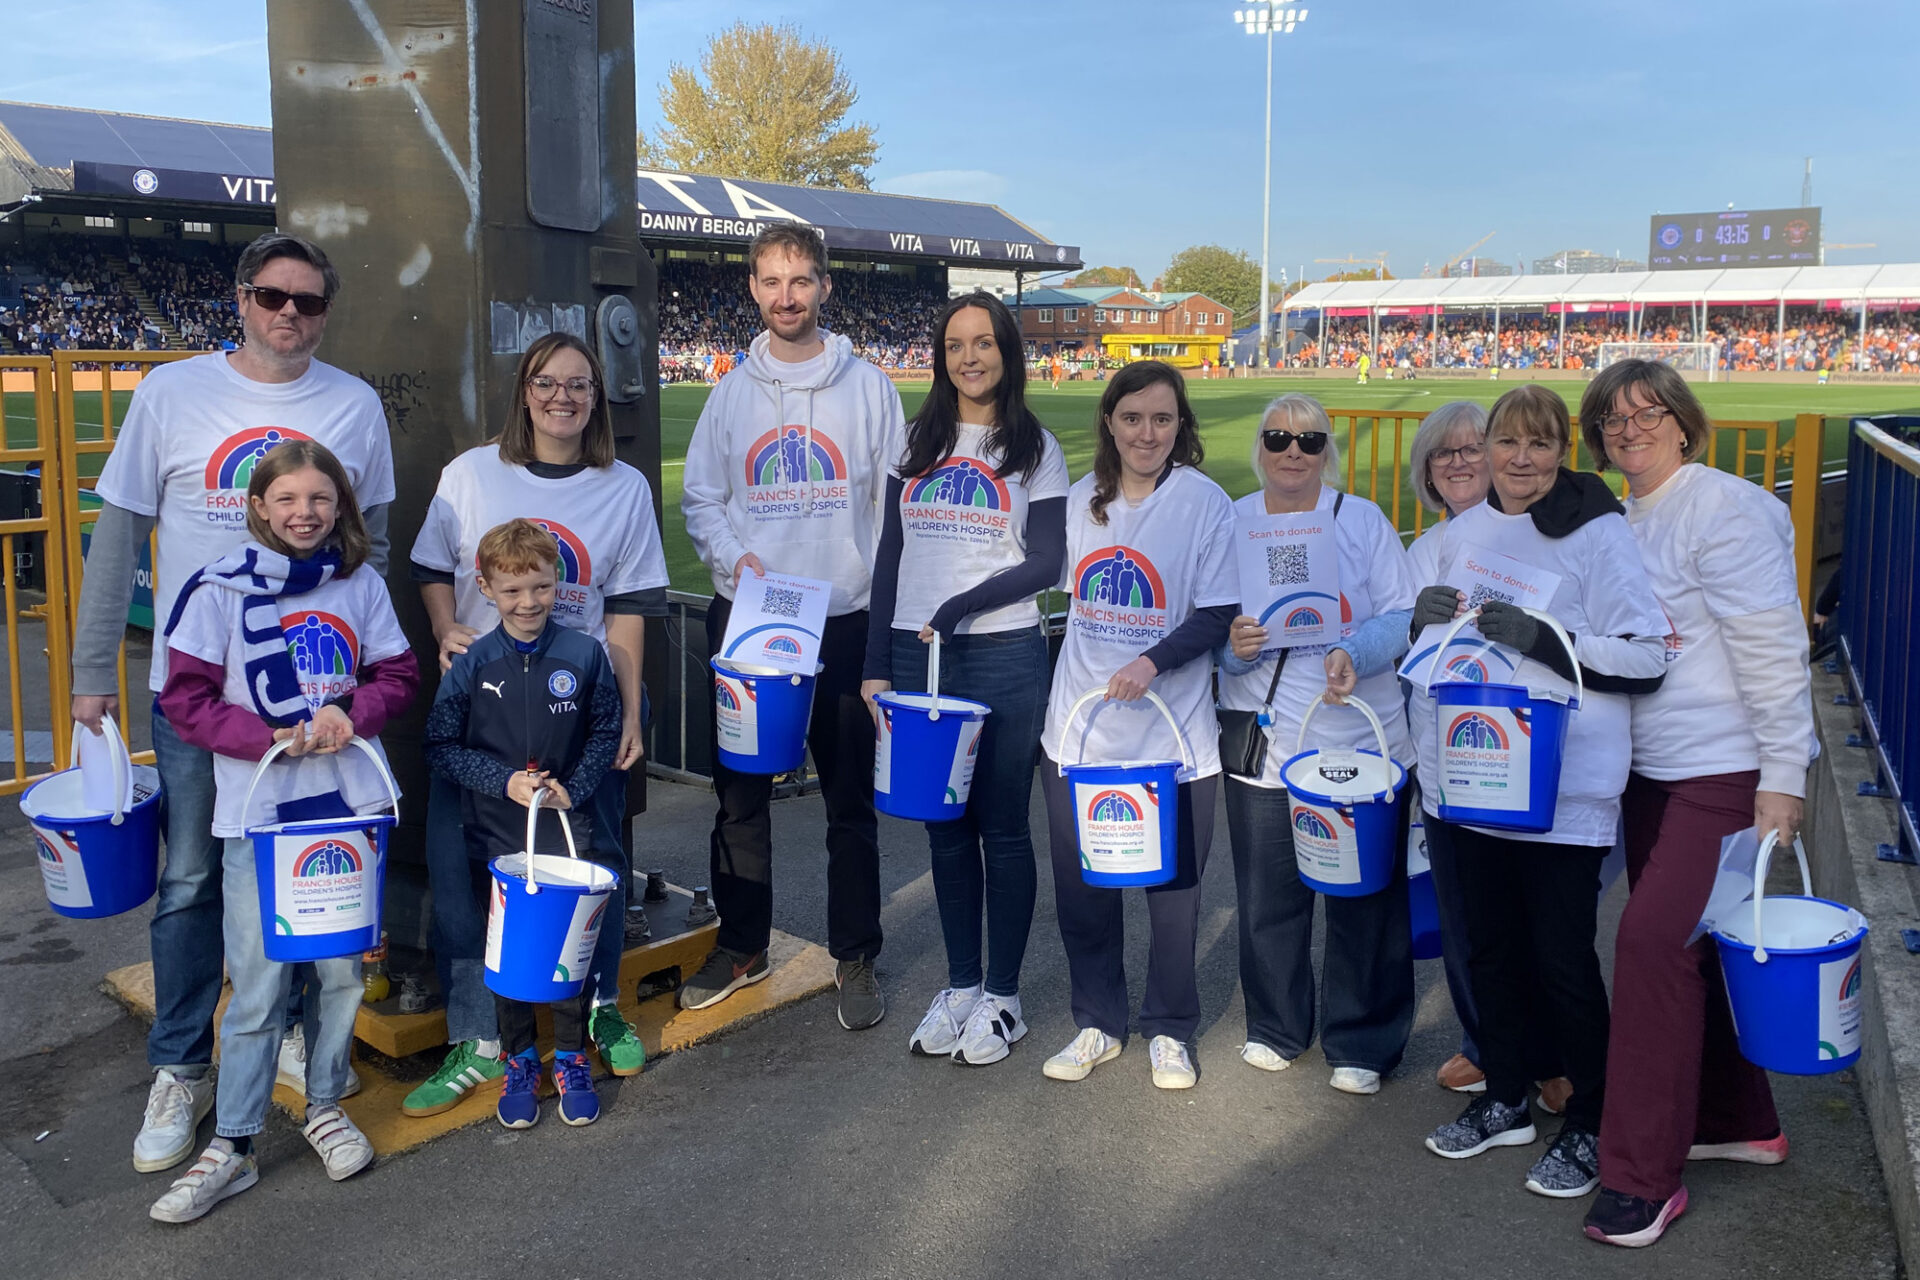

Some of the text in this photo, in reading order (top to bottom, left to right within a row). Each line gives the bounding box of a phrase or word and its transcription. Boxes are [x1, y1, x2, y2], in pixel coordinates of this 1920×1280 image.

[222, 176, 278, 203] VIT
[641, 212, 771, 237] DANNY BERGAR
[889, 232, 924, 252] VITA
[1695, 224, 1771, 245] 0 43:15 0
[950, 237, 981, 257] VITA
[1005, 242, 1035, 260] VITA
[207, 511, 249, 522] CHILD
[903, 508, 1009, 529] FRANCIS HOUSE
[906, 522, 1006, 539] HILDREN'S HOSPICE
[1248, 526, 1323, 540] Scan to donate
[1466, 559, 1539, 596] Scan to donate
[554, 588, 589, 604] USE
[552, 602, 585, 616] SPICE
[1117, 612, 1166, 628] HOUSE
[1119, 626, 1165, 640] HOSPICE
[548, 700, 578, 715] VITA
[1445, 750, 1510, 762] FRANCIS HOUSE
[1479, 761, 1510, 769] HOSPICE
[1325, 771, 1354, 779] SEAL
[1088, 823, 1145, 832] FRANCIS HOUSE
[292, 874, 363, 889] FRANCIS HOUSE
[292, 882, 363, 896] CHILDREN'S HOSPICE
